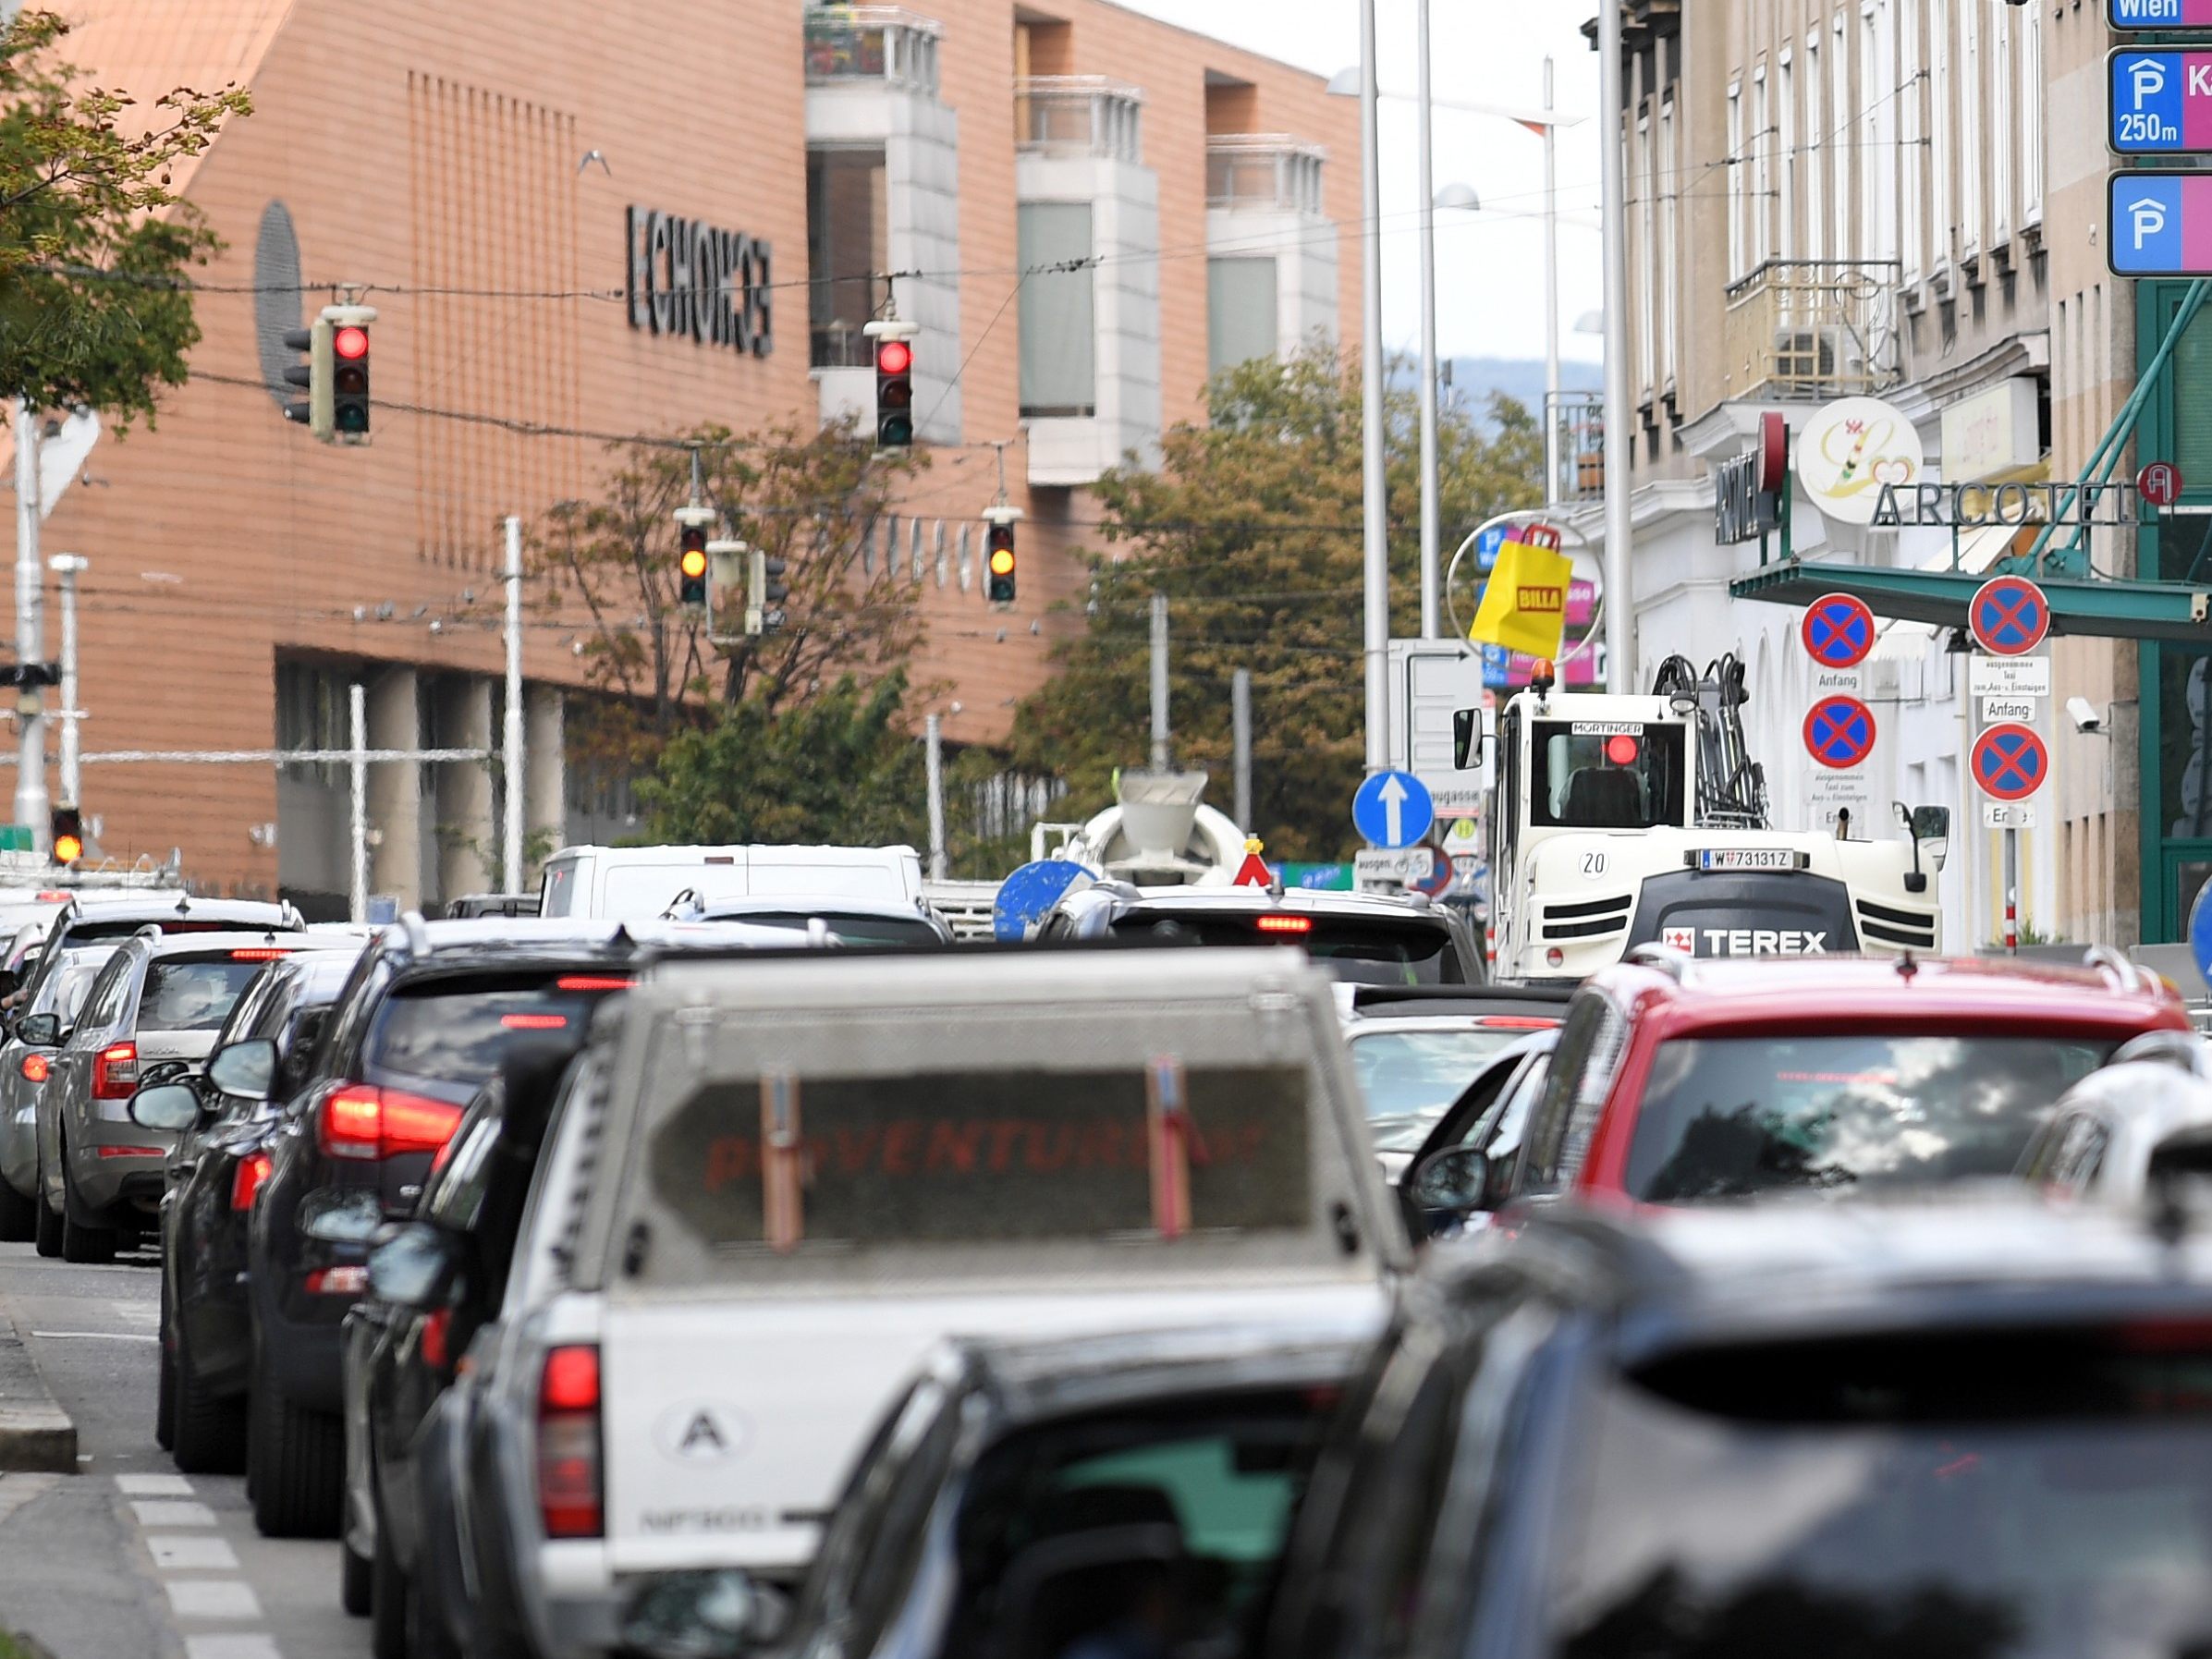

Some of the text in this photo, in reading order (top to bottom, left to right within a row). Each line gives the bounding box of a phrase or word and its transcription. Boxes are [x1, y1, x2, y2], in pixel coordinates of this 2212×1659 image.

[1870, 481, 2139, 528] ARCOTEL
[1519, 589, 1559, 609] BILLA
[1818, 674, 1858, 689] Anfang
[1988, 702, 2029, 719] Anfang
[1584, 853, 1604, 872] 20
[1704, 931, 1827, 955] TEREX
[679, 1409, 727, 1453] A
